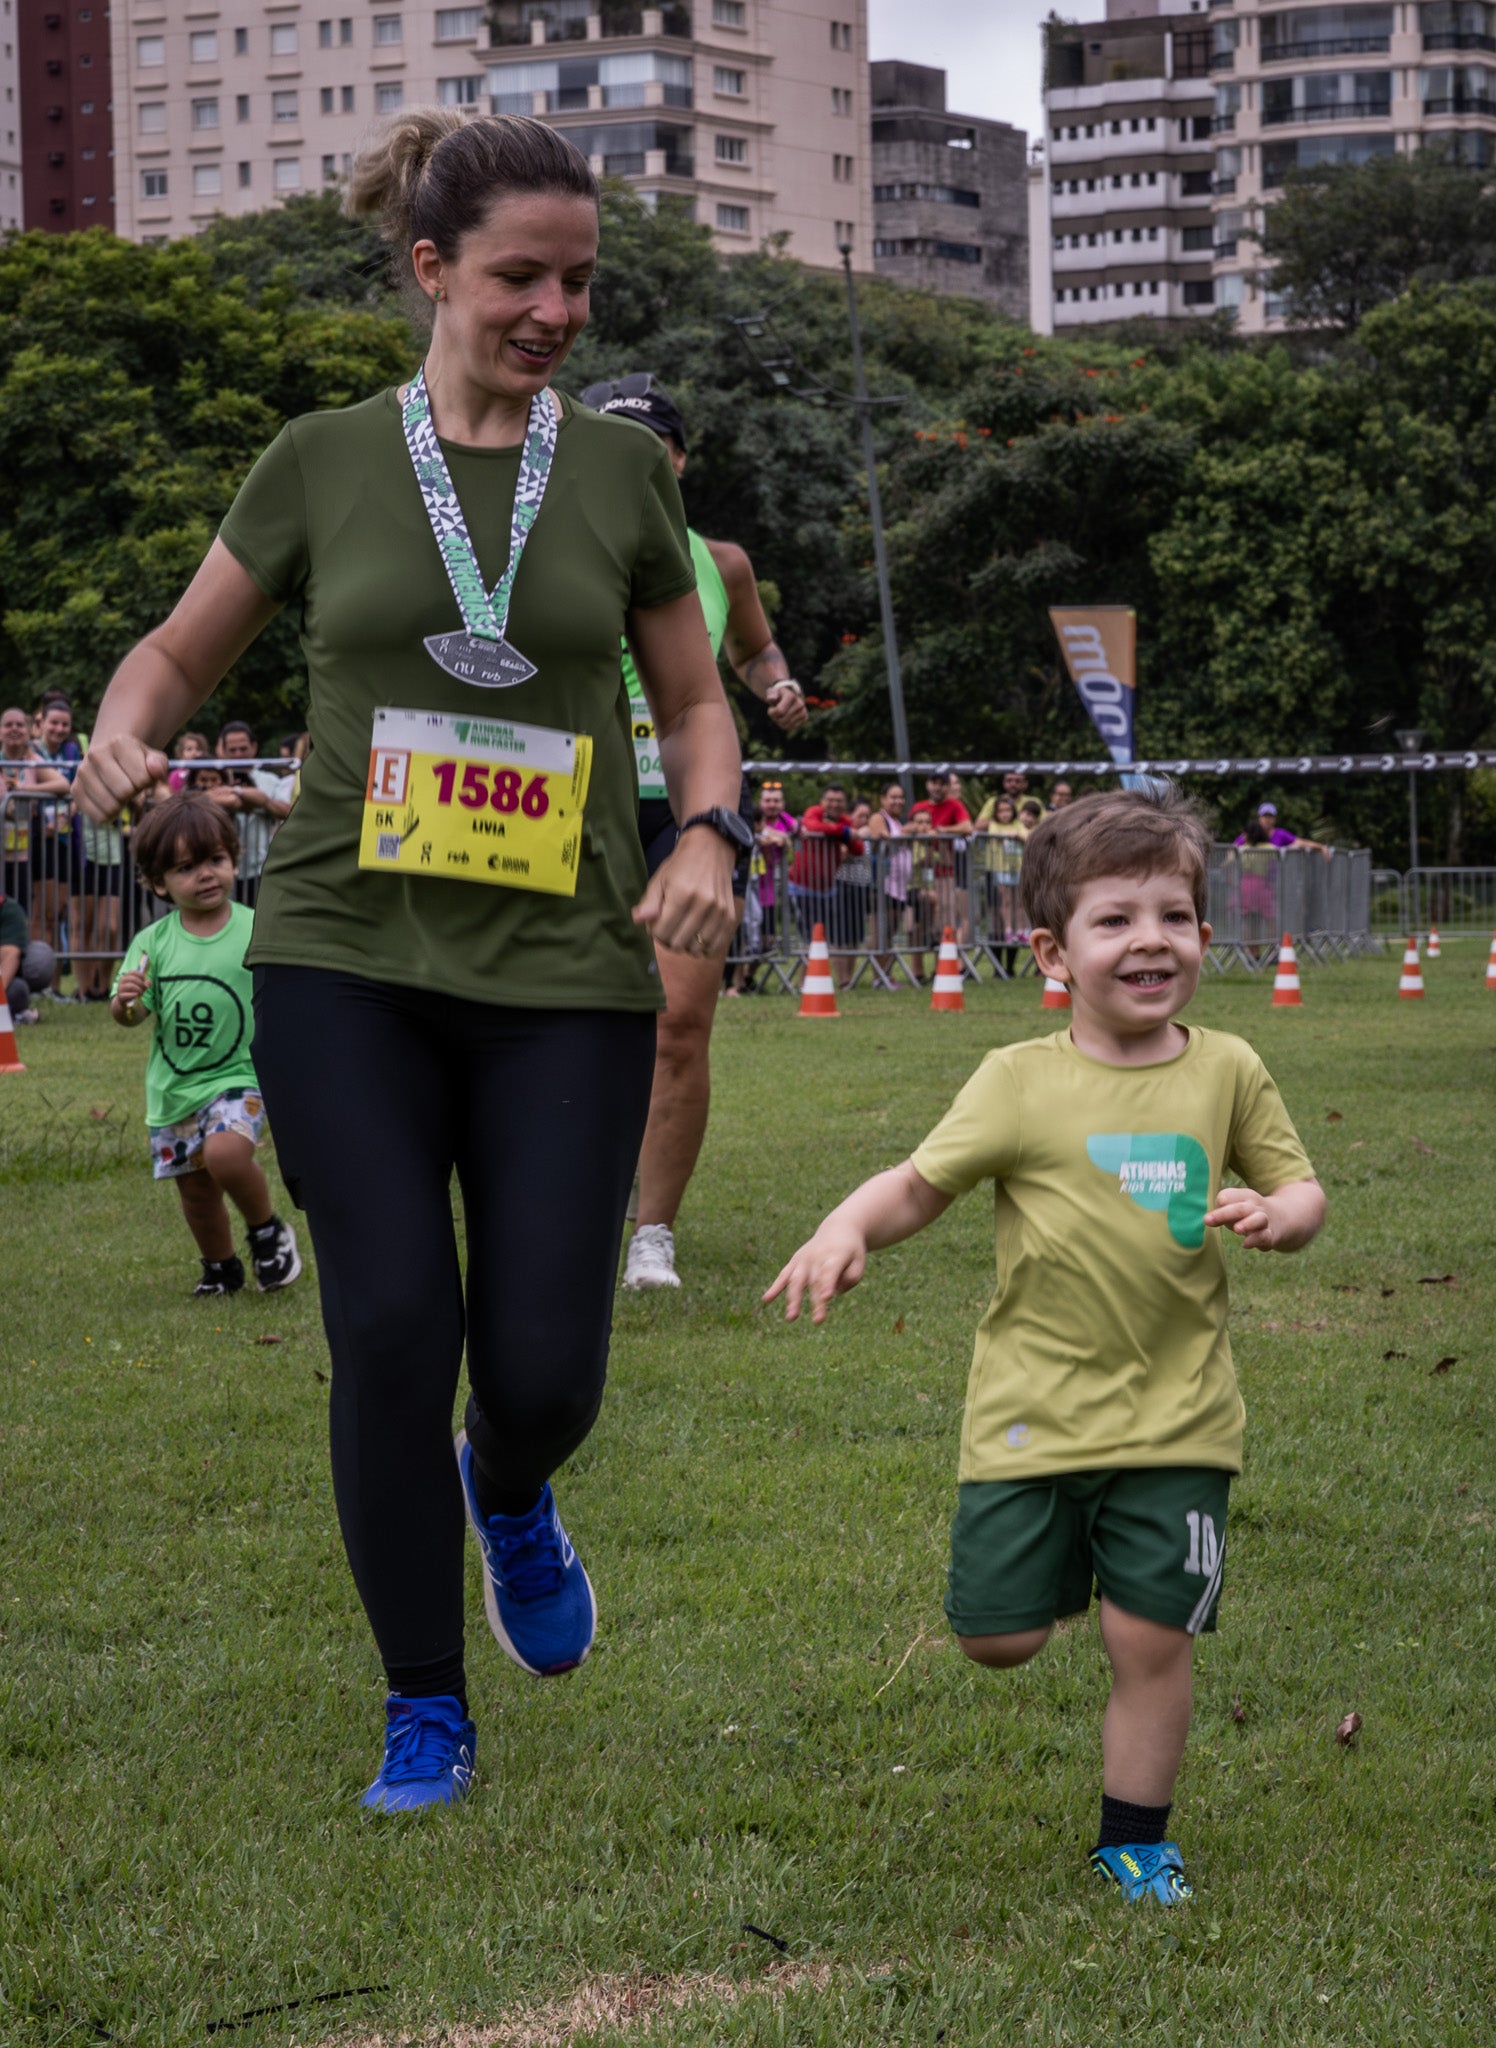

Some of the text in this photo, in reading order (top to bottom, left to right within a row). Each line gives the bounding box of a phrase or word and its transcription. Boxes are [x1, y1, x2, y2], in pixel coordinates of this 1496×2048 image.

[381, 757, 399, 795] E
[432, 760, 550, 820] 1586
[471, 817, 506, 838] LIVIA
[1118, 1160, 1187, 1181] ATHENAS
[1119, 1181, 1187, 1194] KIDS FASTER
[1184, 1510, 1218, 1578] 10
[1120, 1851, 1142, 1878] umbro
